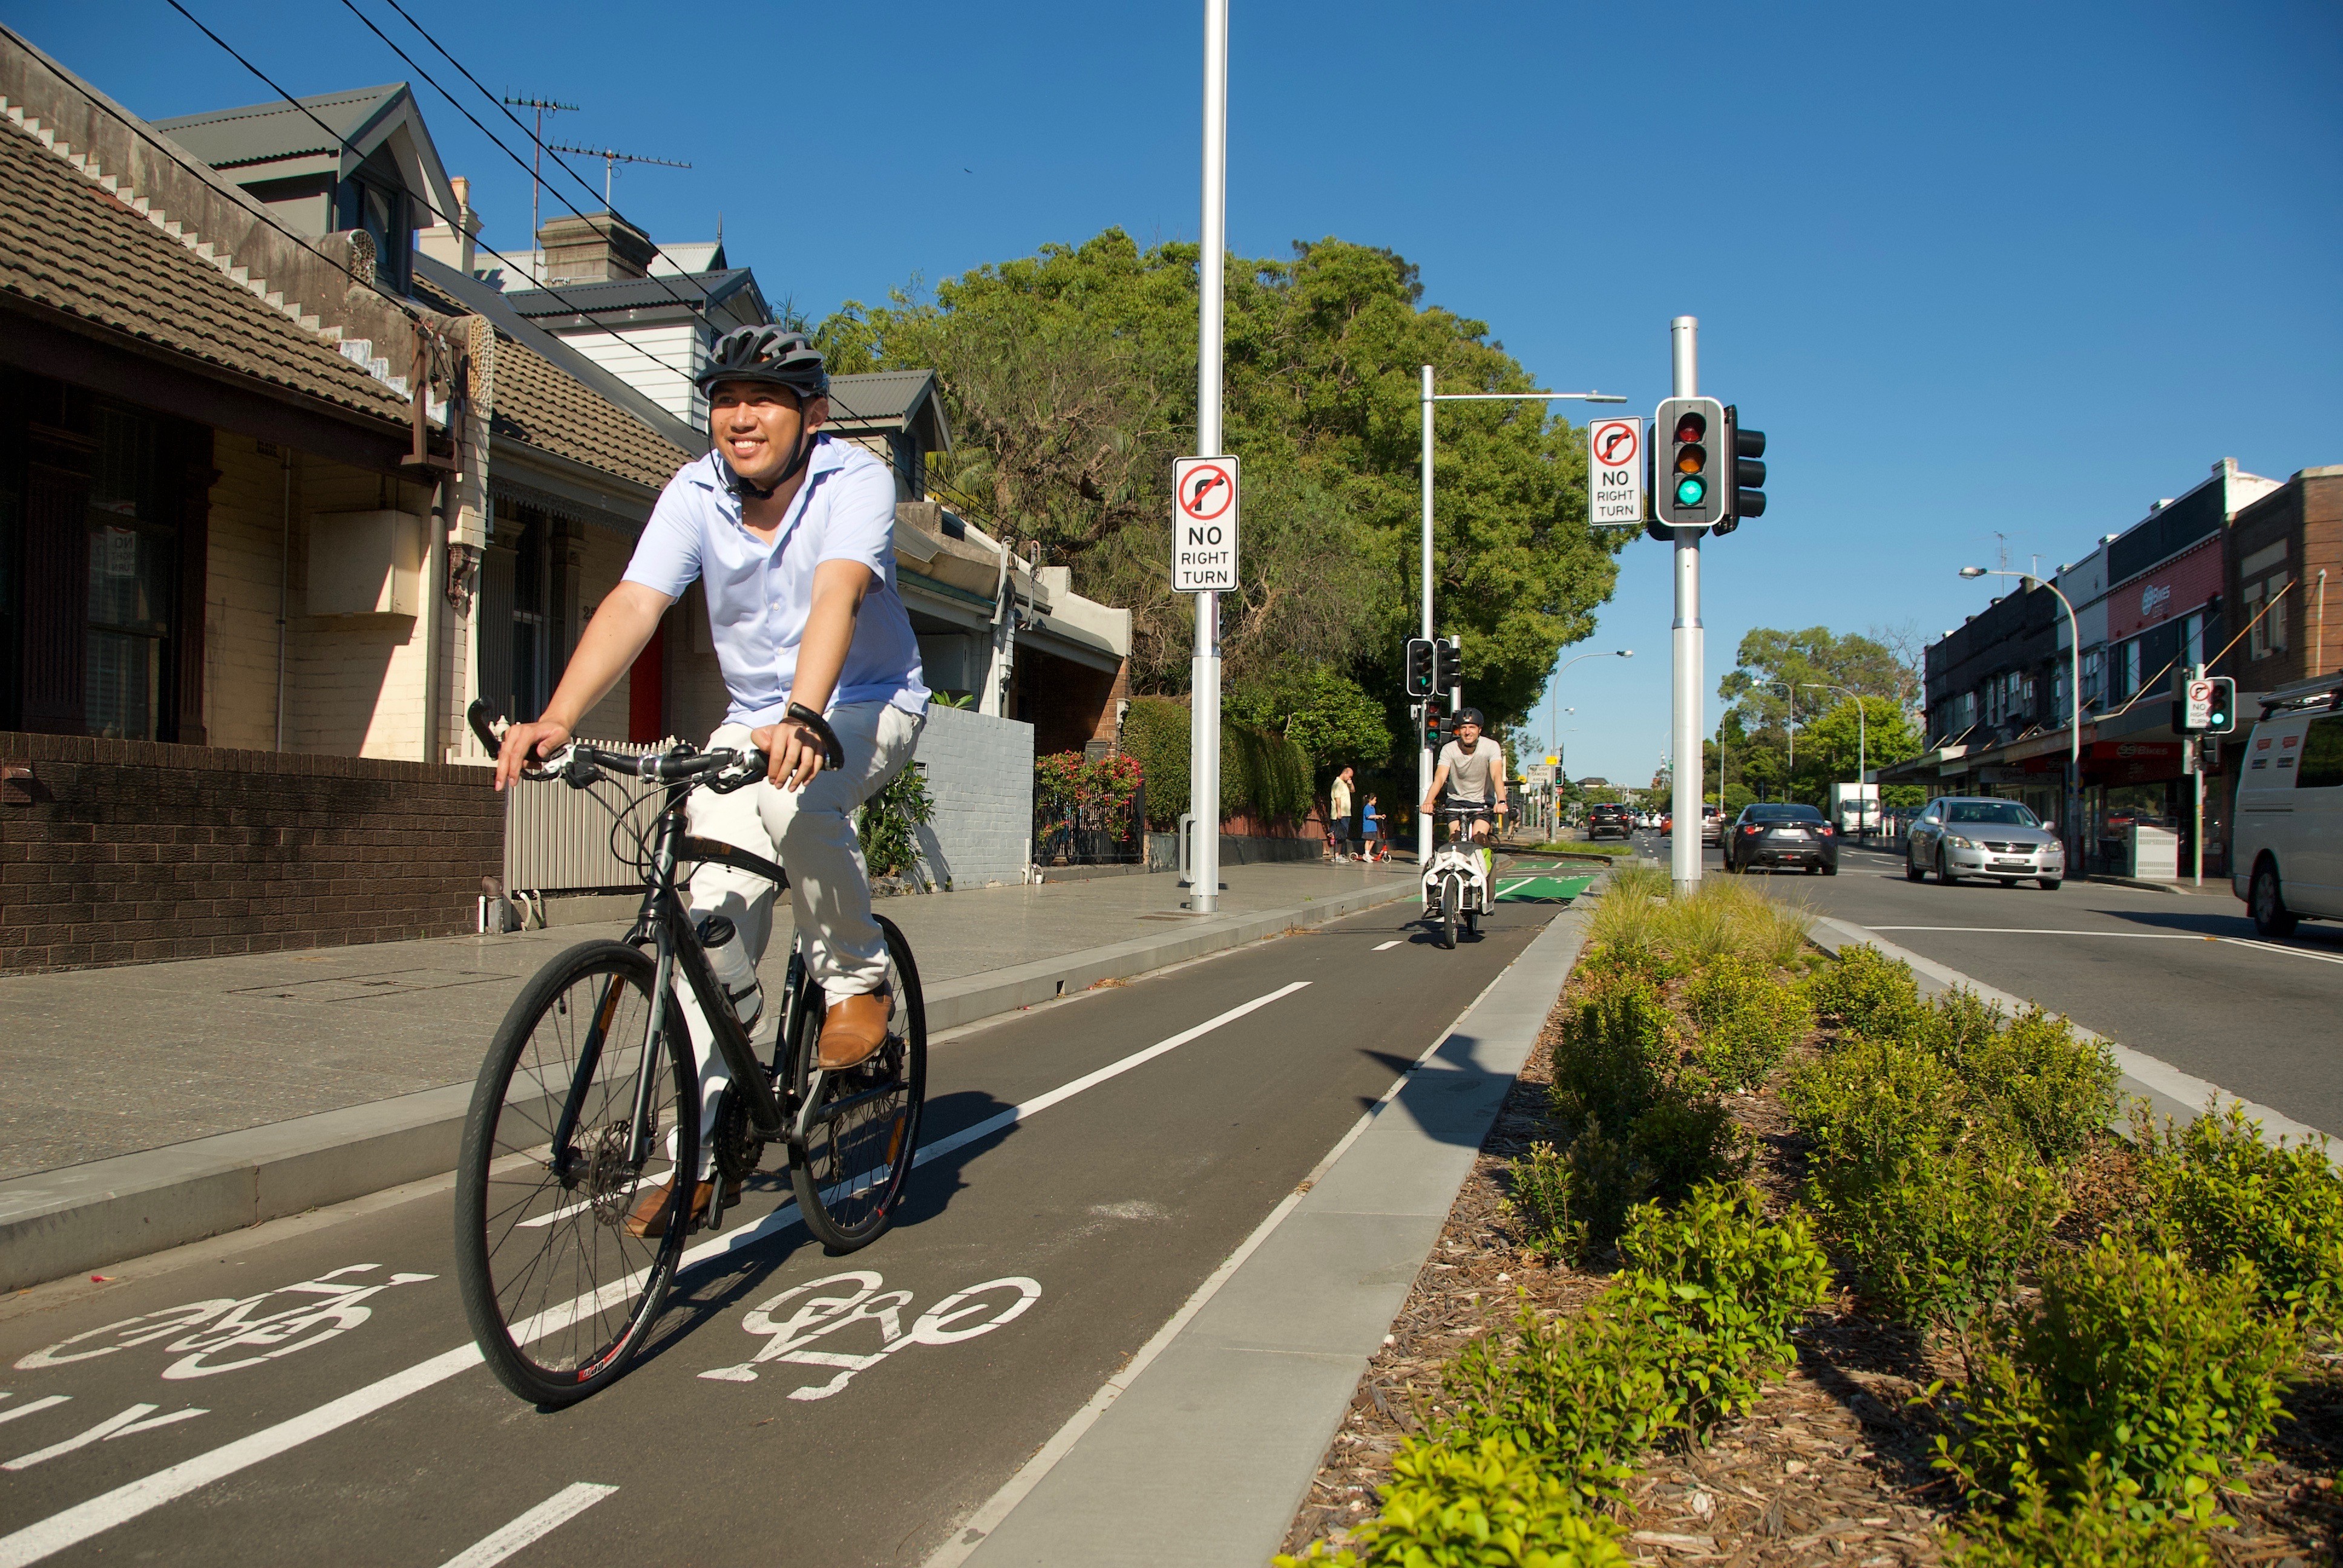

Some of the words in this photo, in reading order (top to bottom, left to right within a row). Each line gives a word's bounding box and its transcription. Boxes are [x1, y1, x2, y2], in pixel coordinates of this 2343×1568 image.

[1603, 471, 1629, 486] NO
[1598, 490, 1634, 501] RIGHT
[1599, 505, 1633, 517] TURN
[1189, 527, 1222, 545] NO
[1182, 552, 1228, 564] RIGHT
[1183, 570, 1228, 584] TURN
